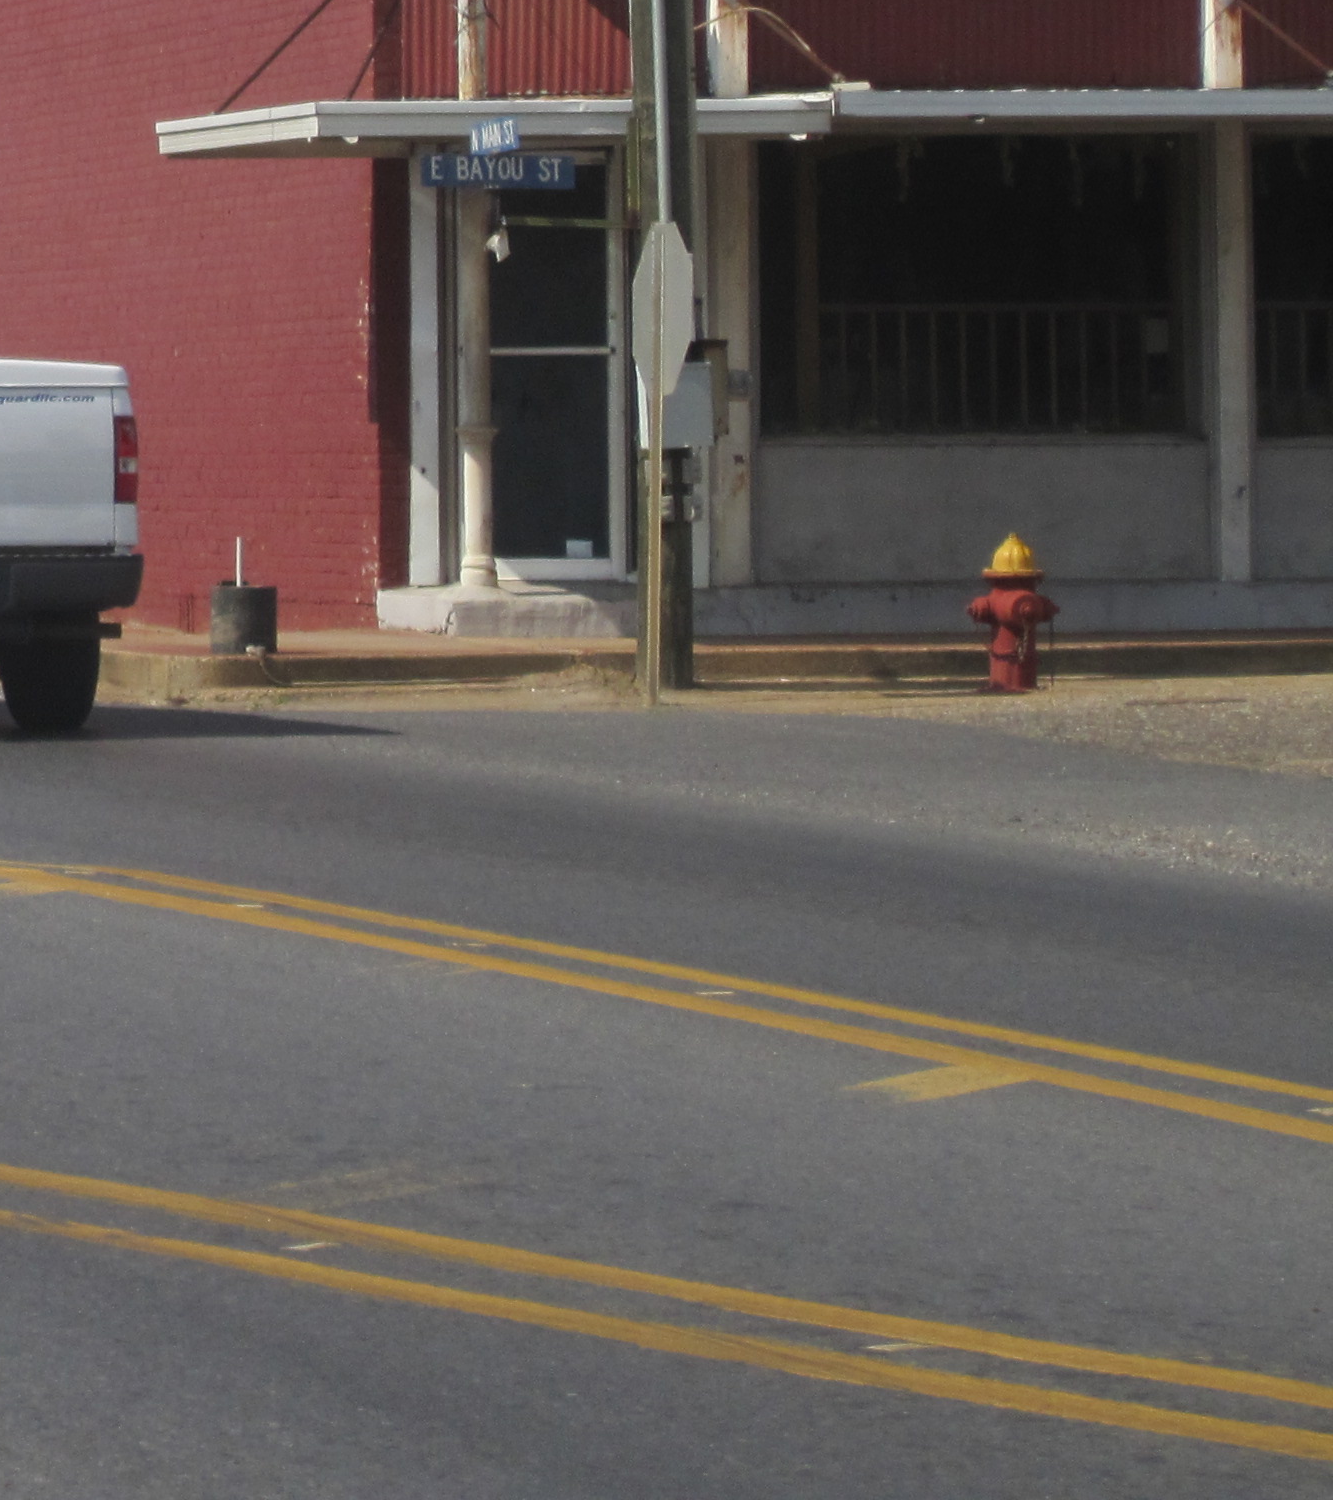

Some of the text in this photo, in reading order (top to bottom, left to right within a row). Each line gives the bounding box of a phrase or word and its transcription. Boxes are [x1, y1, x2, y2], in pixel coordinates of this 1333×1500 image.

[471, 119, 515, 151] N MAIN ST
[431, 155, 562, 182] E BAYOU ST
